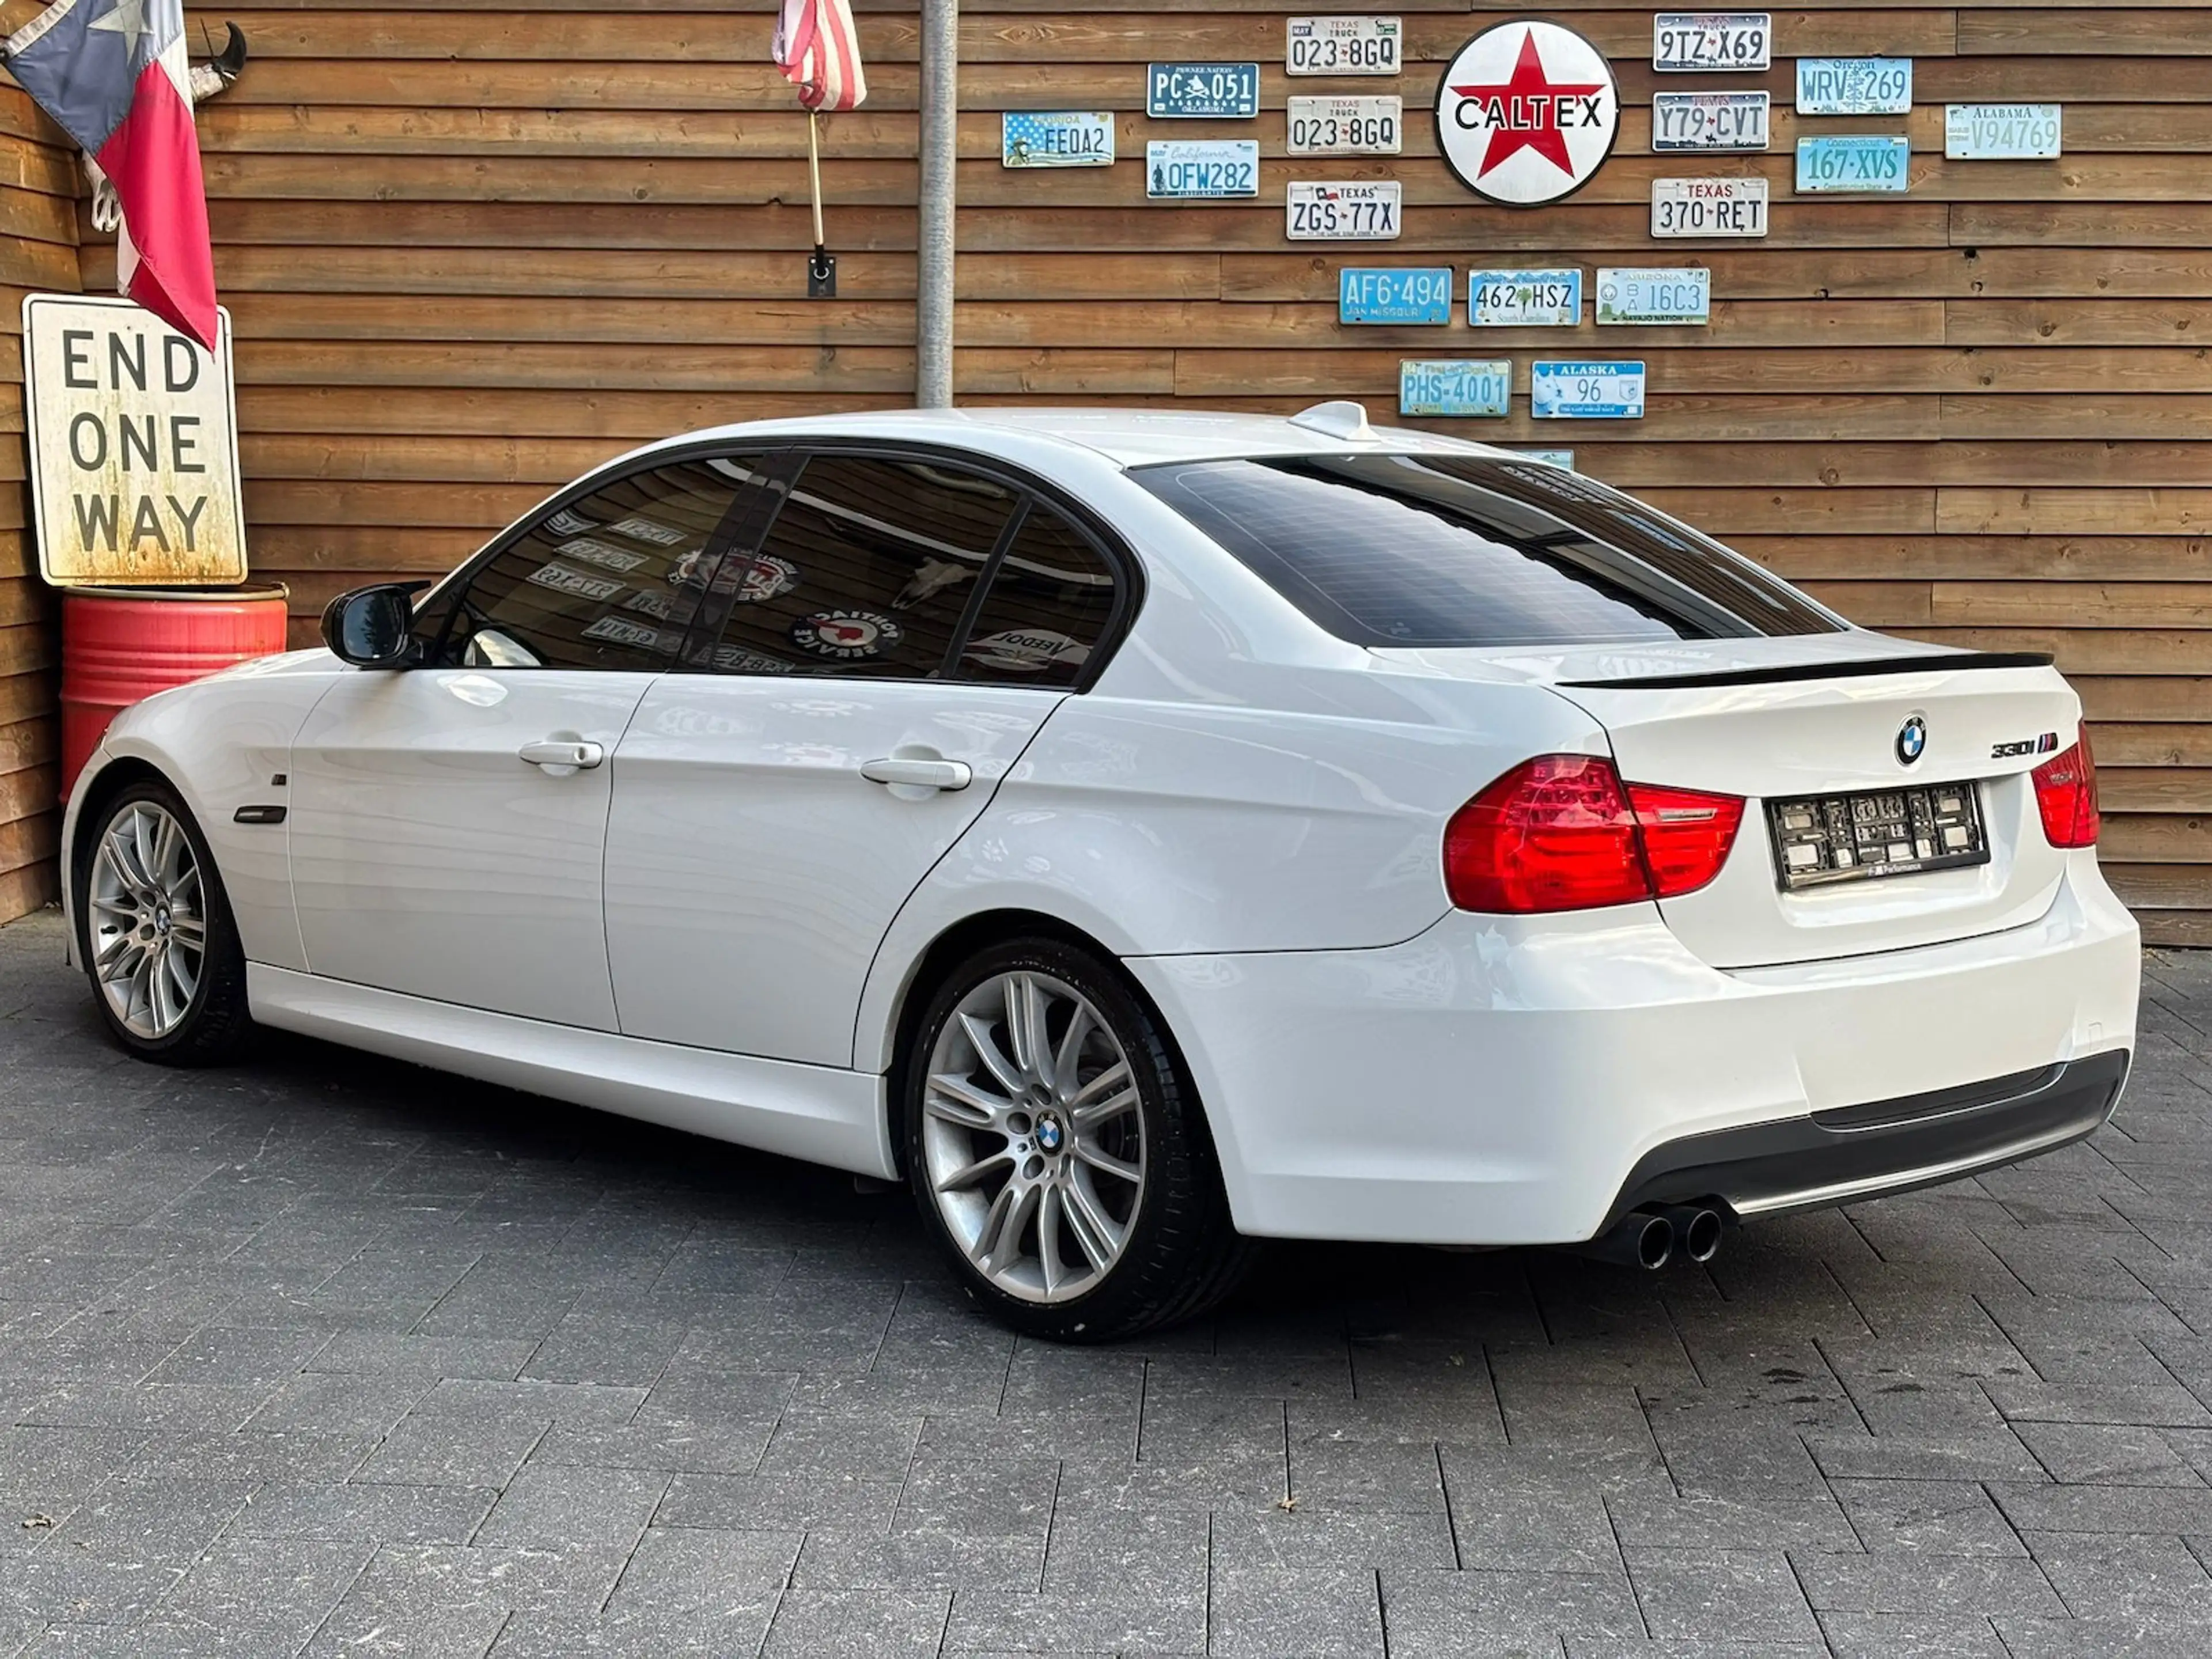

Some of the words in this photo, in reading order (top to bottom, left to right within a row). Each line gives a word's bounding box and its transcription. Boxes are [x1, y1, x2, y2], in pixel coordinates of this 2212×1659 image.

[1293, 39, 1337, 66] 023
[1350, 37, 1393, 66] 8GQ
[1661, 31, 1706, 59] 9TZ
[1718, 30, 1763, 59] X69
[1156, 73, 1183, 99] PC
[1211, 73, 1252, 100] 051
[1802, 70, 1847, 101] WRV
[1864, 70, 1906, 100] 269
[1455, 96, 1602, 130] CALTEX
[1660, 107, 1706, 137] Y79
[1716, 107, 1763, 136] CVT
[1974, 107, 2033, 118] ALABAMA
[1293, 119, 1337, 146] 023
[1350, 118, 1393, 145] 8GQ
[1971, 120, 2057, 149] V94769
[1339, 187, 1375, 199] TEXAS
[1687, 185, 1733, 198] TEXAS
[1293, 203, 1337, 230] ZGS
[1349, 203, 1393, 230] 77X
[1660, 201, 1704, 229] 370
[1717, 200, 1761, 229] RET
[1476, 285, 1517, 308] 462
[1532, 285, 1572, 308] HSZ
[1649, 285, 1700, 310] 16C3
[62, 329, 199, 393] END
[1560, 365, 1618, 375] ALASKA
[1577, 378, 1601, 402] 96
[69, 412, 206, 473] ONE
[73, 494, 208, 552] WAY
